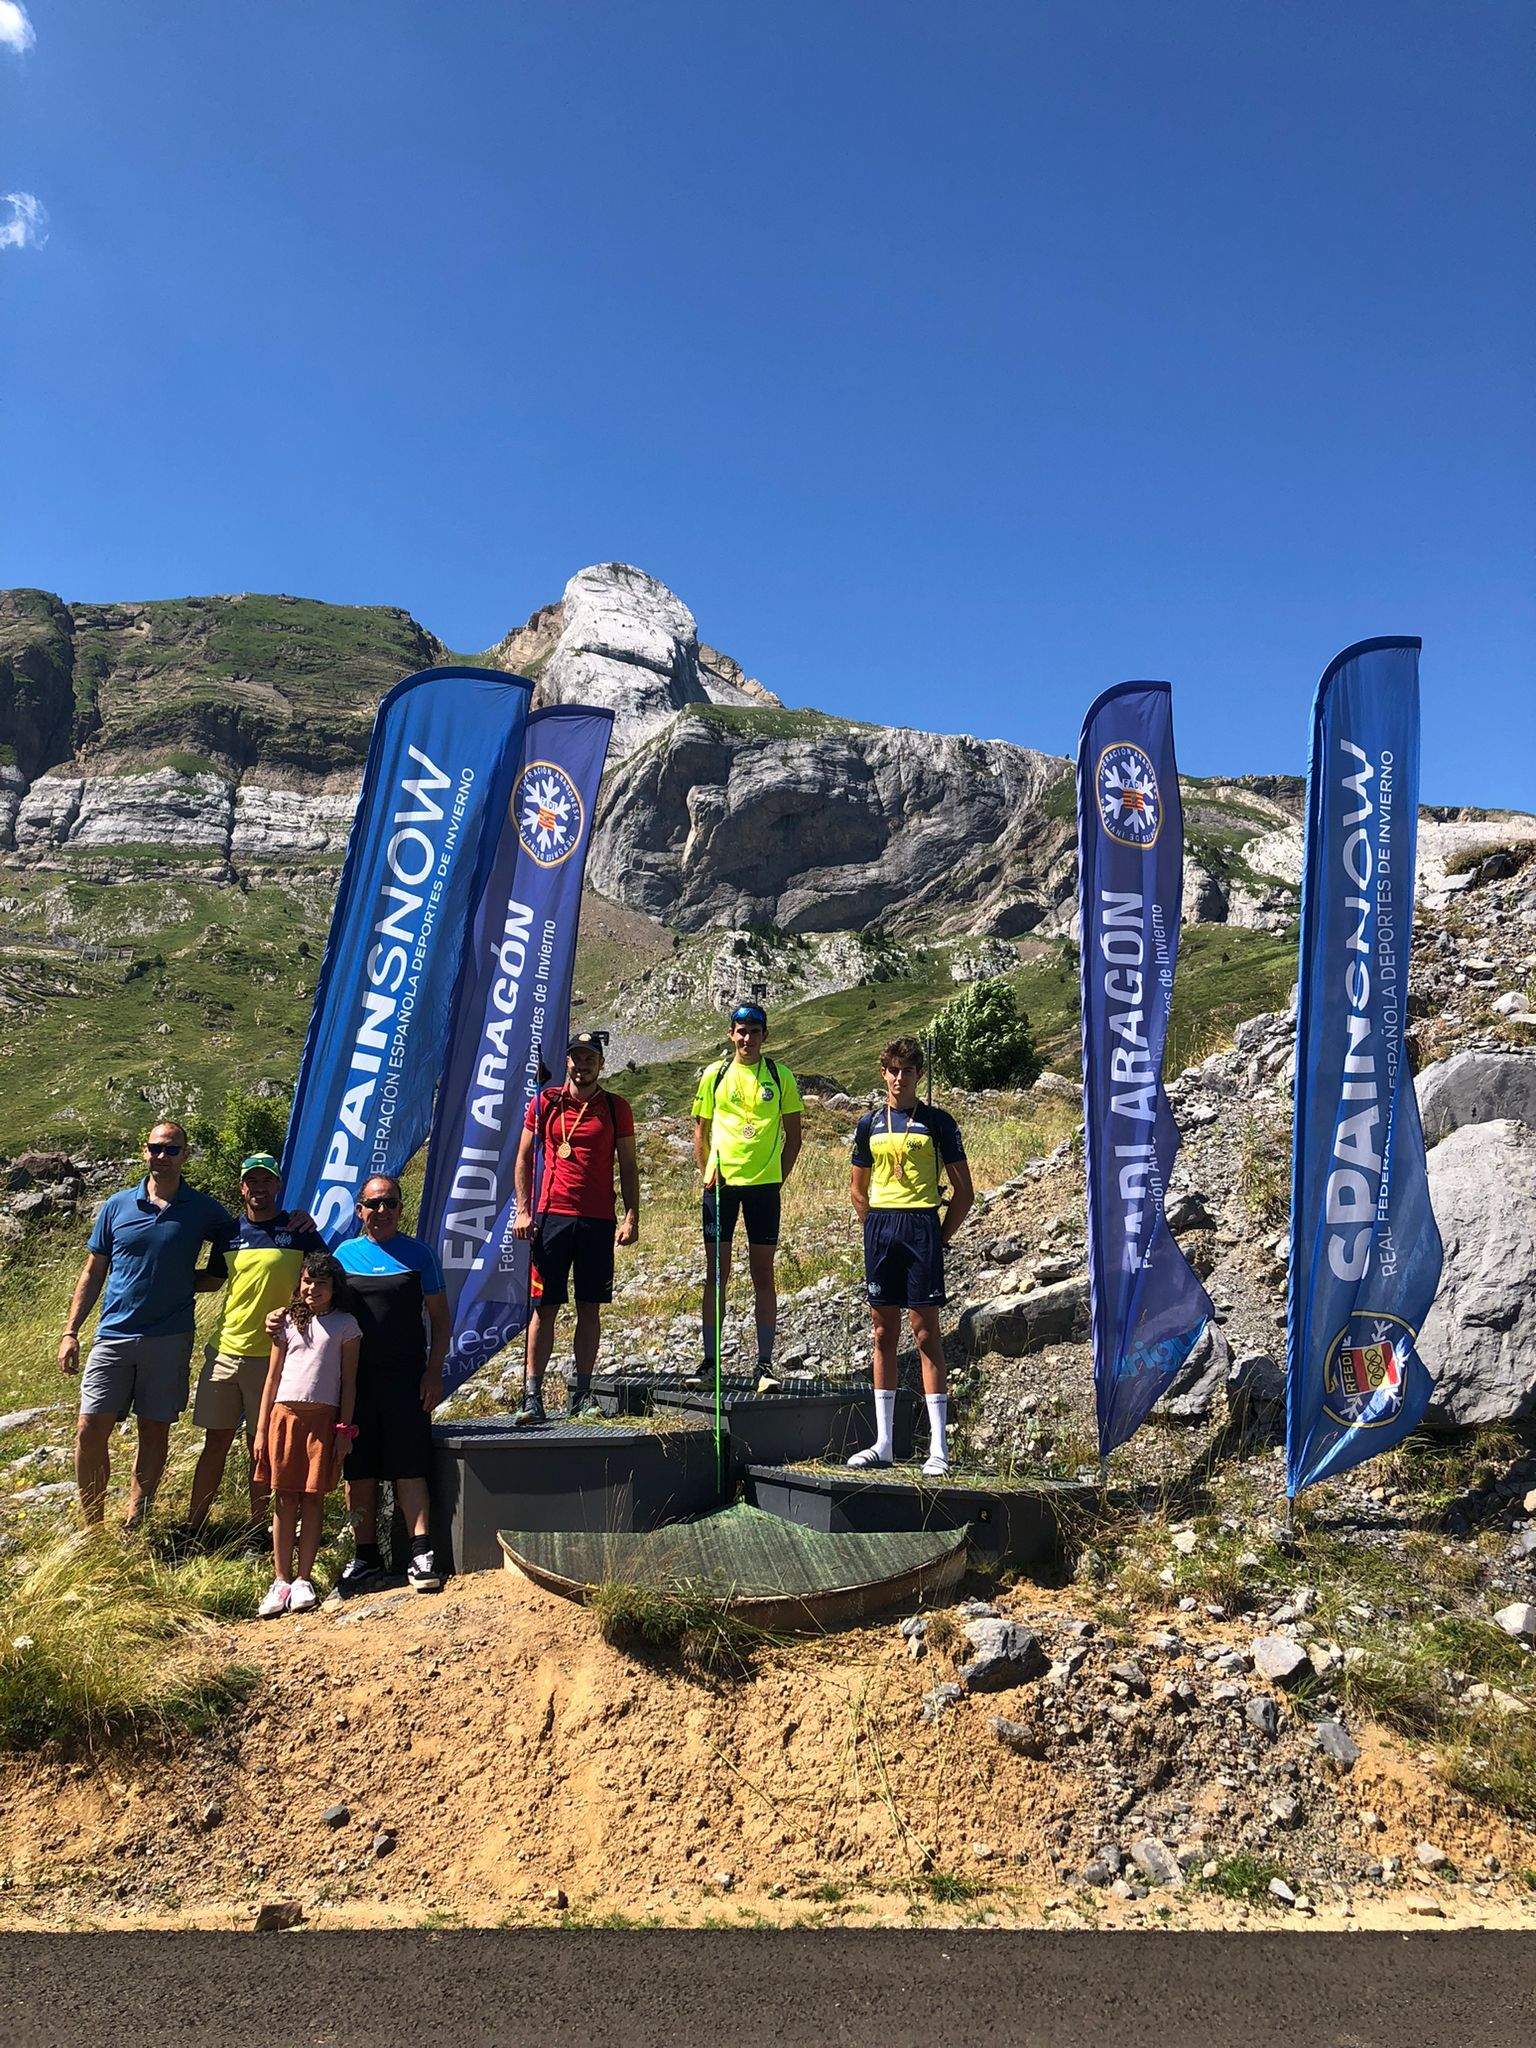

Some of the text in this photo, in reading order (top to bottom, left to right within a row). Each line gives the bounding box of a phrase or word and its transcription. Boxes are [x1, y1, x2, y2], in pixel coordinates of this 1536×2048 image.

[1378, 750, 1394, 844] INVIERNO
[1378, 848, 1391, 875] DE
[369, 767, 475, 1176] EDERACIÓN ESPAÑOLA DEPORTES DE INVIERNO
[1151, 904, 1169, 964] Invierno
[1159, 969, 1172, 986] de
[1377, 880, 1395, 978] DEPORTES
[310, 744, 452, 1236] SPAINSNOW
[1101, 890, 1158, 1123] ARAGÓN
[1326, 738, 1382, 1281] SPAINSNOW
[1381, 985, 1400, 1092] ESPAÑOLA
[442, 899, 534, 1270] FADI ARAGÓN
[498, 920, 557, 1272] Federació de Deportes de Invierno
[1377, 1226, 1398, 1277] REAL
